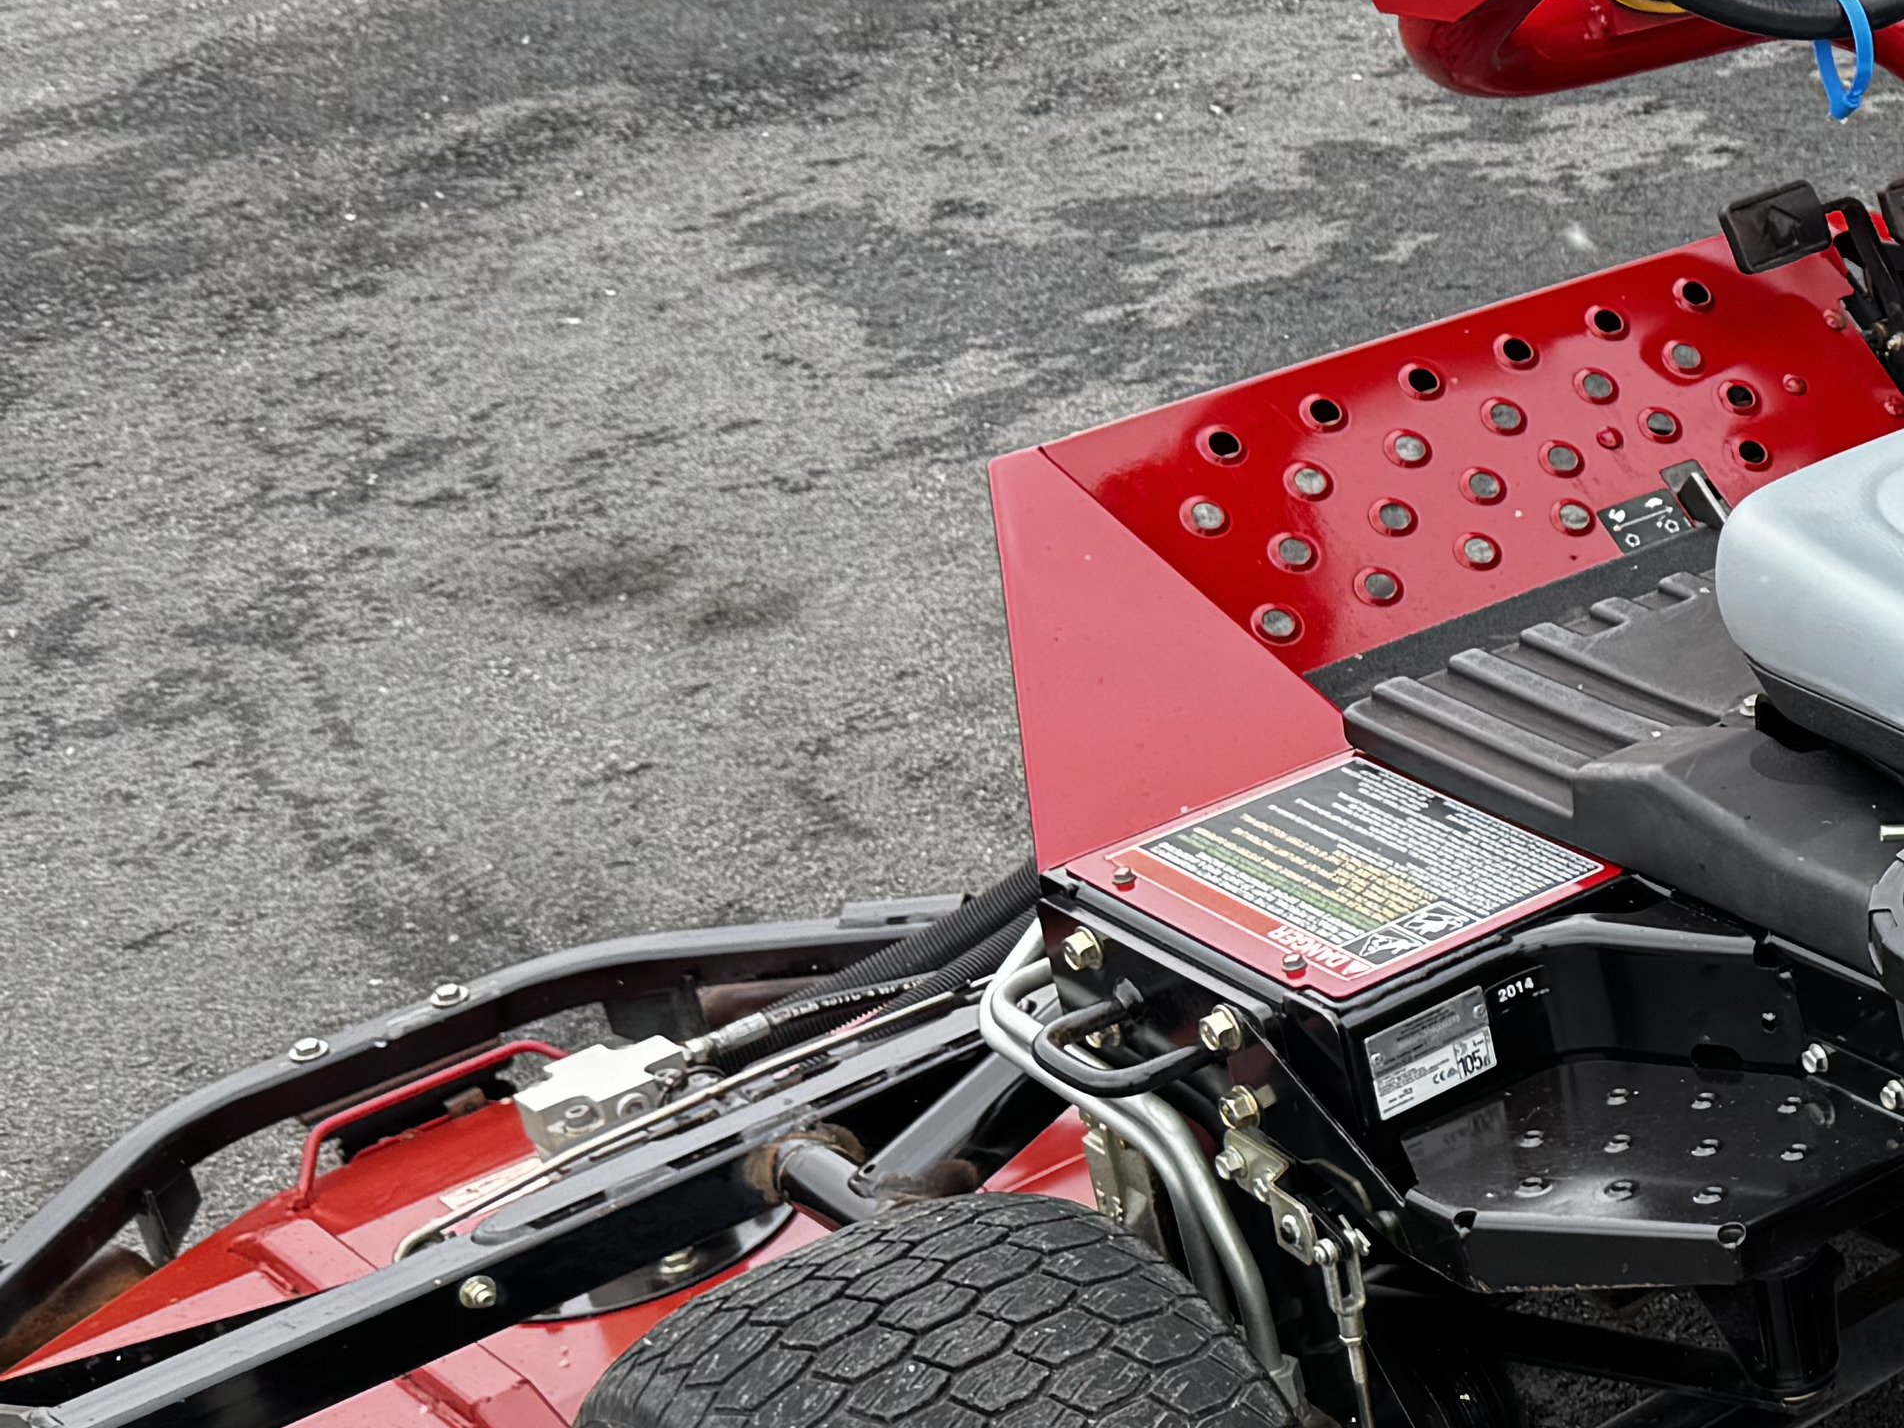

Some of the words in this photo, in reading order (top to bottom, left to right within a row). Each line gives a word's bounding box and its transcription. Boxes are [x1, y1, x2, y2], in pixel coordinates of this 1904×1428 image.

[1267, 925, 1352, 968] DANGER
[1497, 976, 1535, 1003] 2014
[1458, 1048, 1483, 1077] 105
